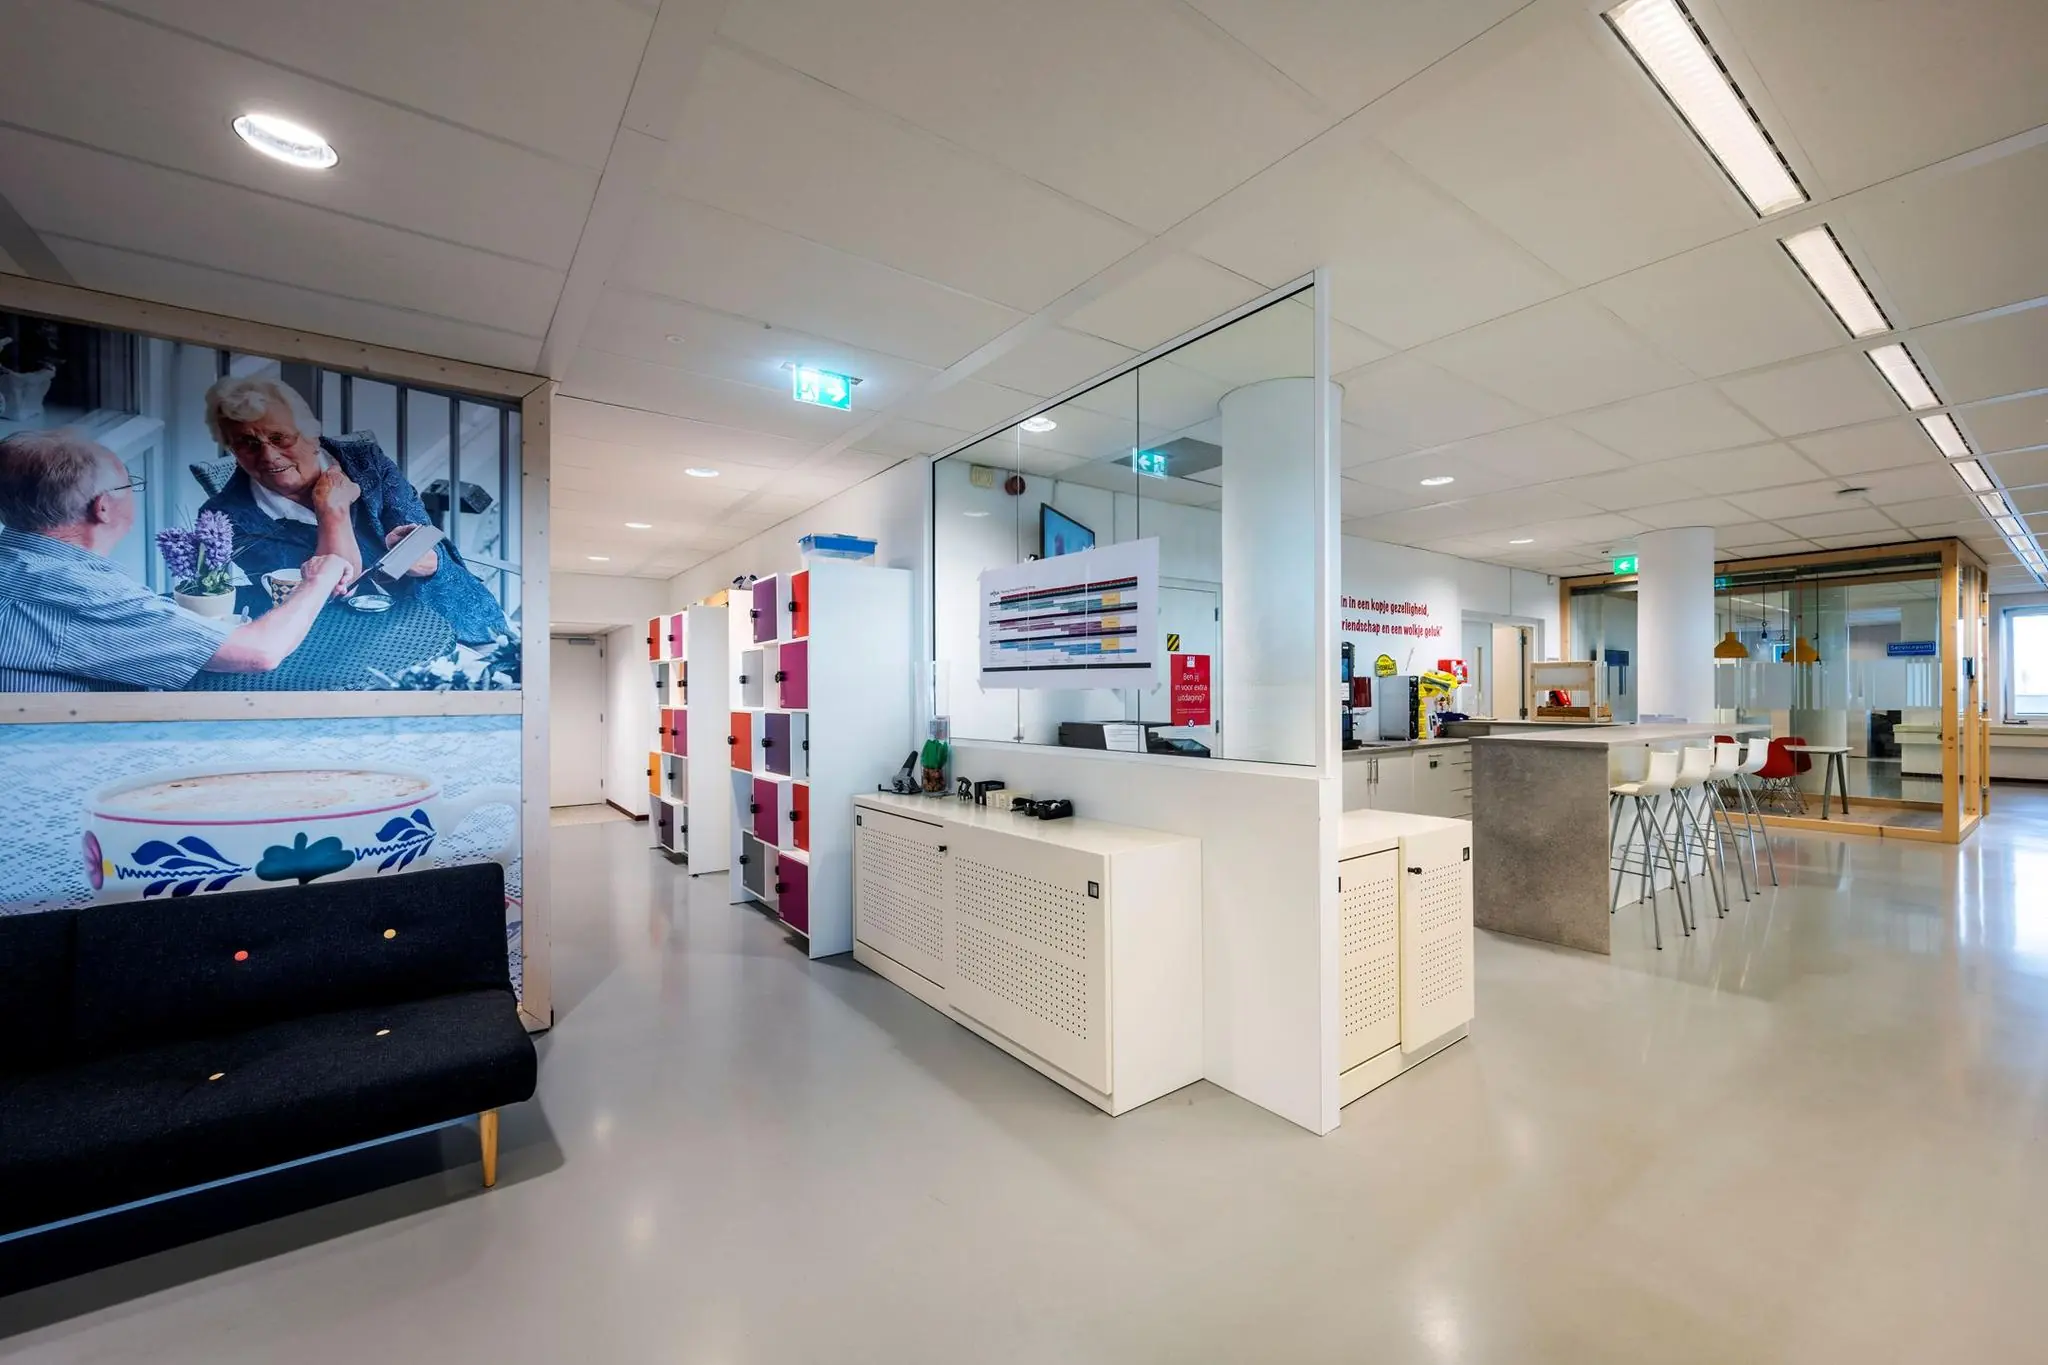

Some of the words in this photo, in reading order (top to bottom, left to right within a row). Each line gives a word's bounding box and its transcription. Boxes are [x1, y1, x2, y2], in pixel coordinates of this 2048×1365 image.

[1349, 596, 1356, 608] in
[1357, 600, 1369, 610] een
[1371, 598, 1389, 614] kopje
[1390, 602, 1429, 617] gezelligheid,
[1341, 619, 1380, 635] riendschap
[1382, 624, 1390, 634] en
[1391, 625, 1402, 635] een
[1404, 624, 1423, 638] wolkje
[1183, 673, 1193, 681] Ben
[1177, 694, 1205, 703] uitdaging?
